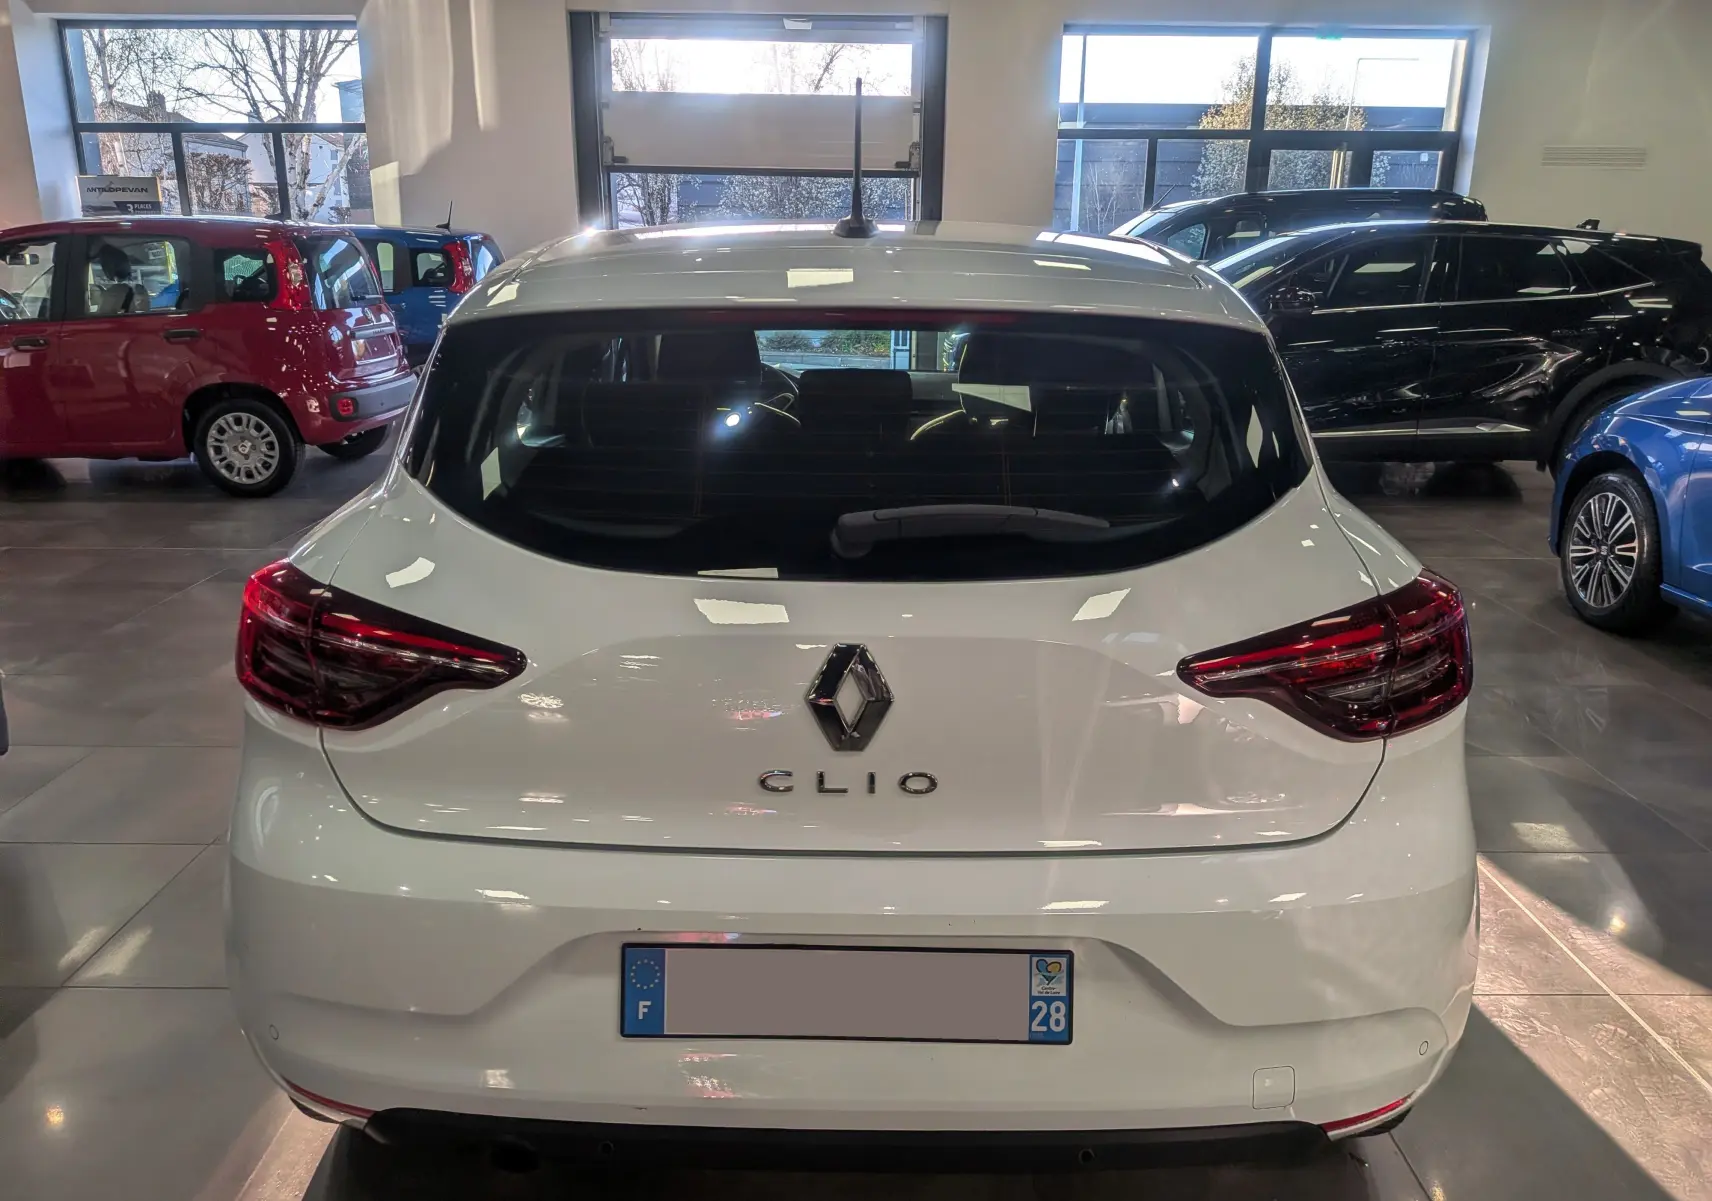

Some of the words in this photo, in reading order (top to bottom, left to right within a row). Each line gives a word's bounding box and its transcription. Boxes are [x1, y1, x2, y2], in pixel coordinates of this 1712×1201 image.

[758, 769, 939, 795] CLIO
[638, 1000, 652, 1020] F
[1031, 1000, 1066, 1032] 28
